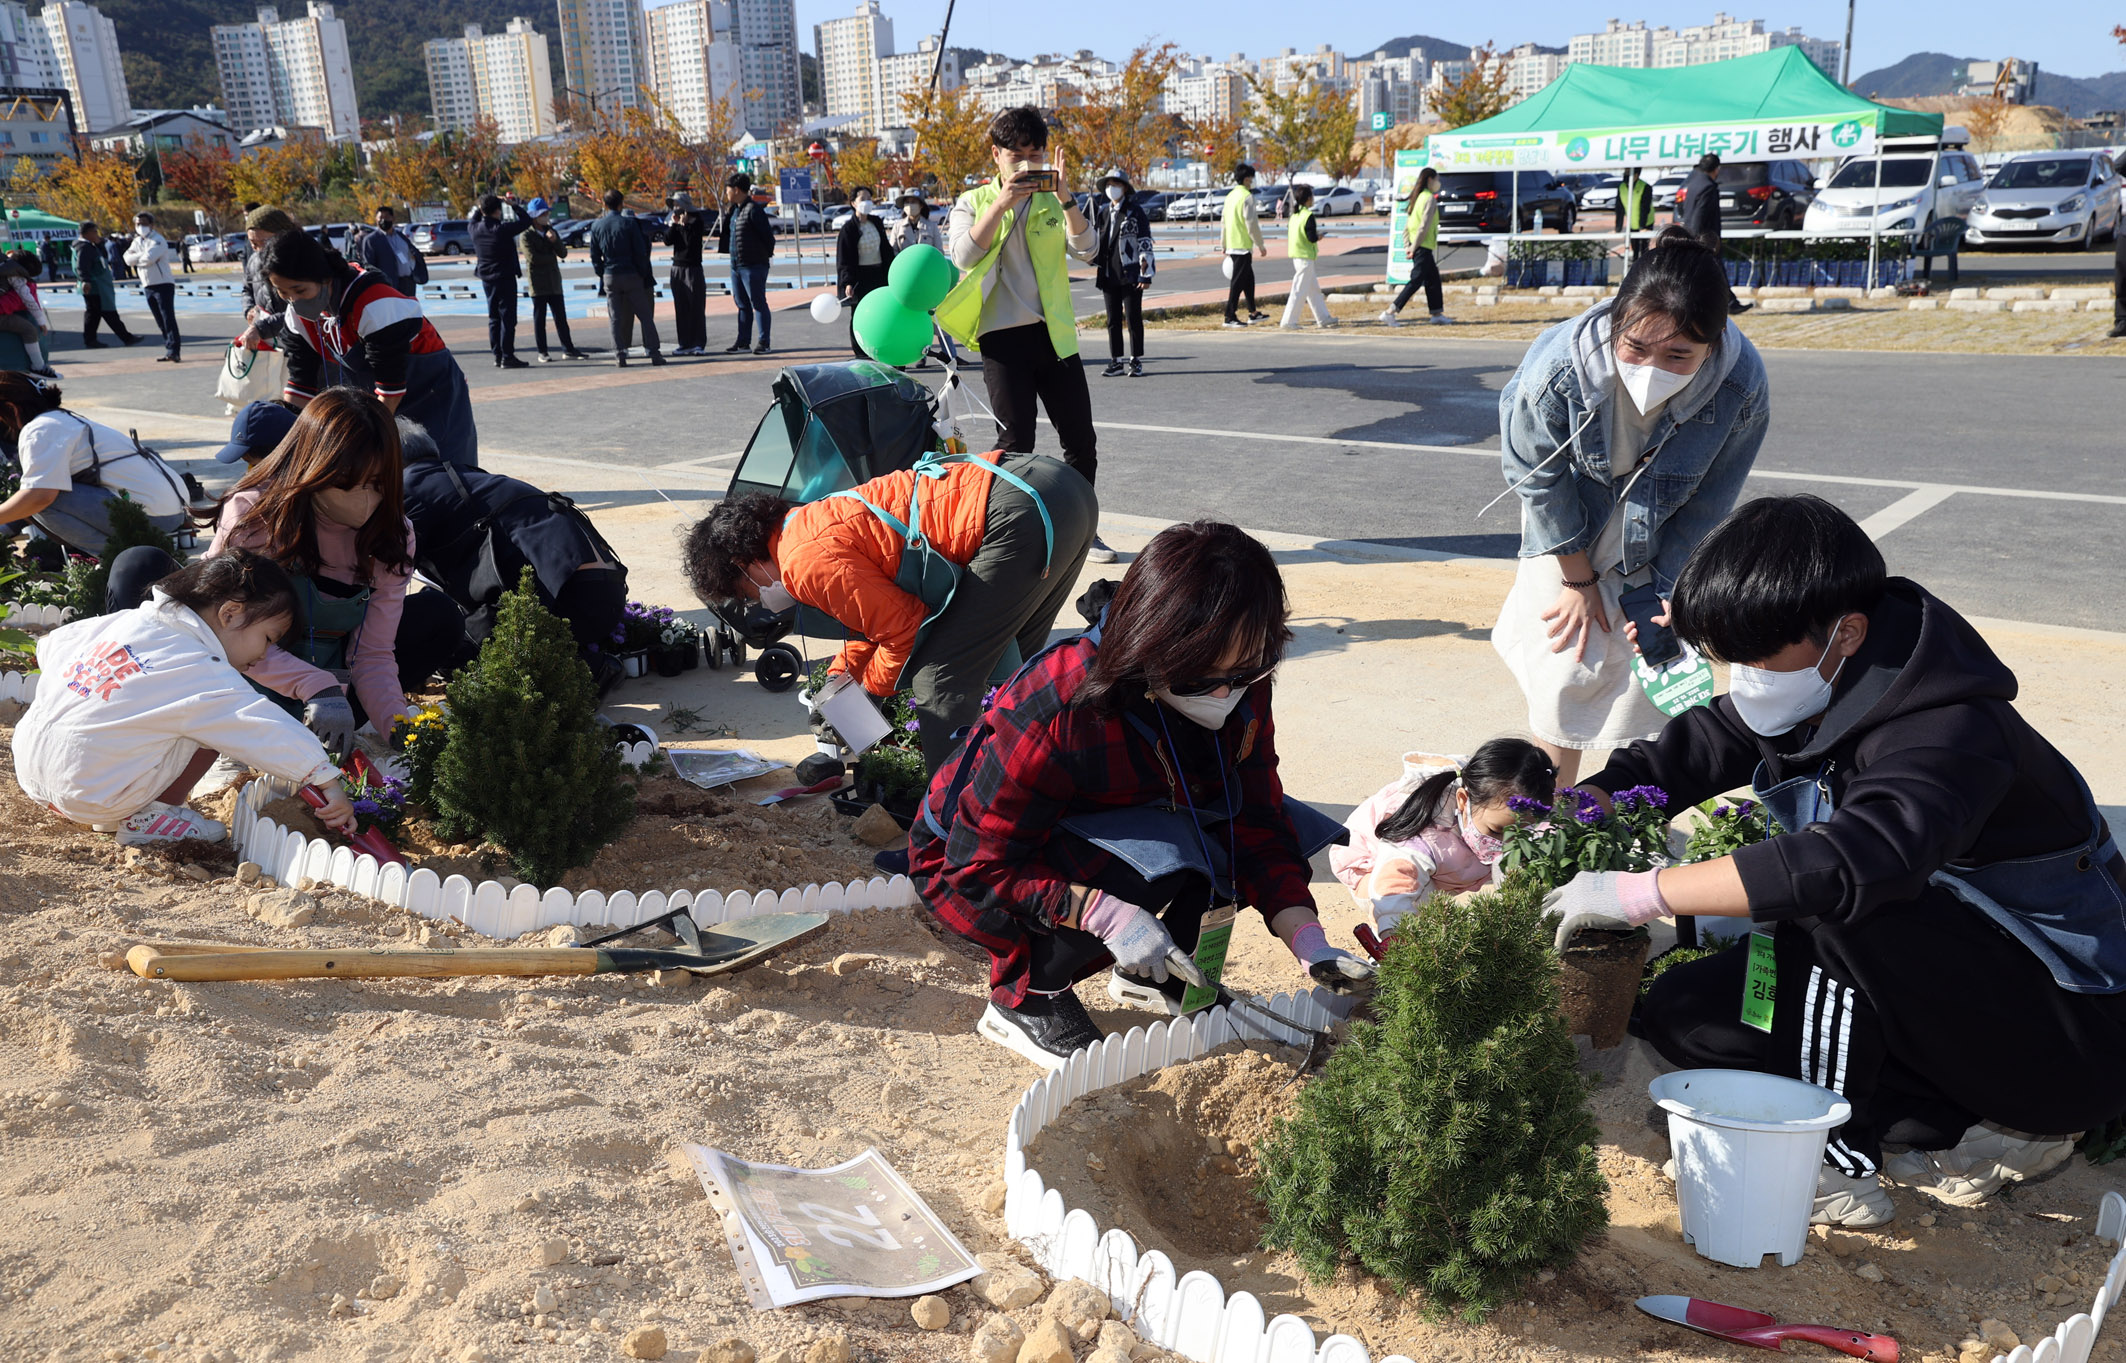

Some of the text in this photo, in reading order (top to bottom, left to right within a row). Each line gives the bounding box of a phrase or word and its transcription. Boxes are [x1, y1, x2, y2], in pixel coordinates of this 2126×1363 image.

[1373, 114, 1385, 128] B
[1605, 126, 1821, 161] 나무 나눠주기 행사
[738, 160, 746, 172] A
[790, 176, 796, 190] P
[84, 658, 112, 676] AND
[87, 641, 141, 681] HIDE
[63, 660, 122, 702] SEEK
[798, 1202, 902, 1250] 22
